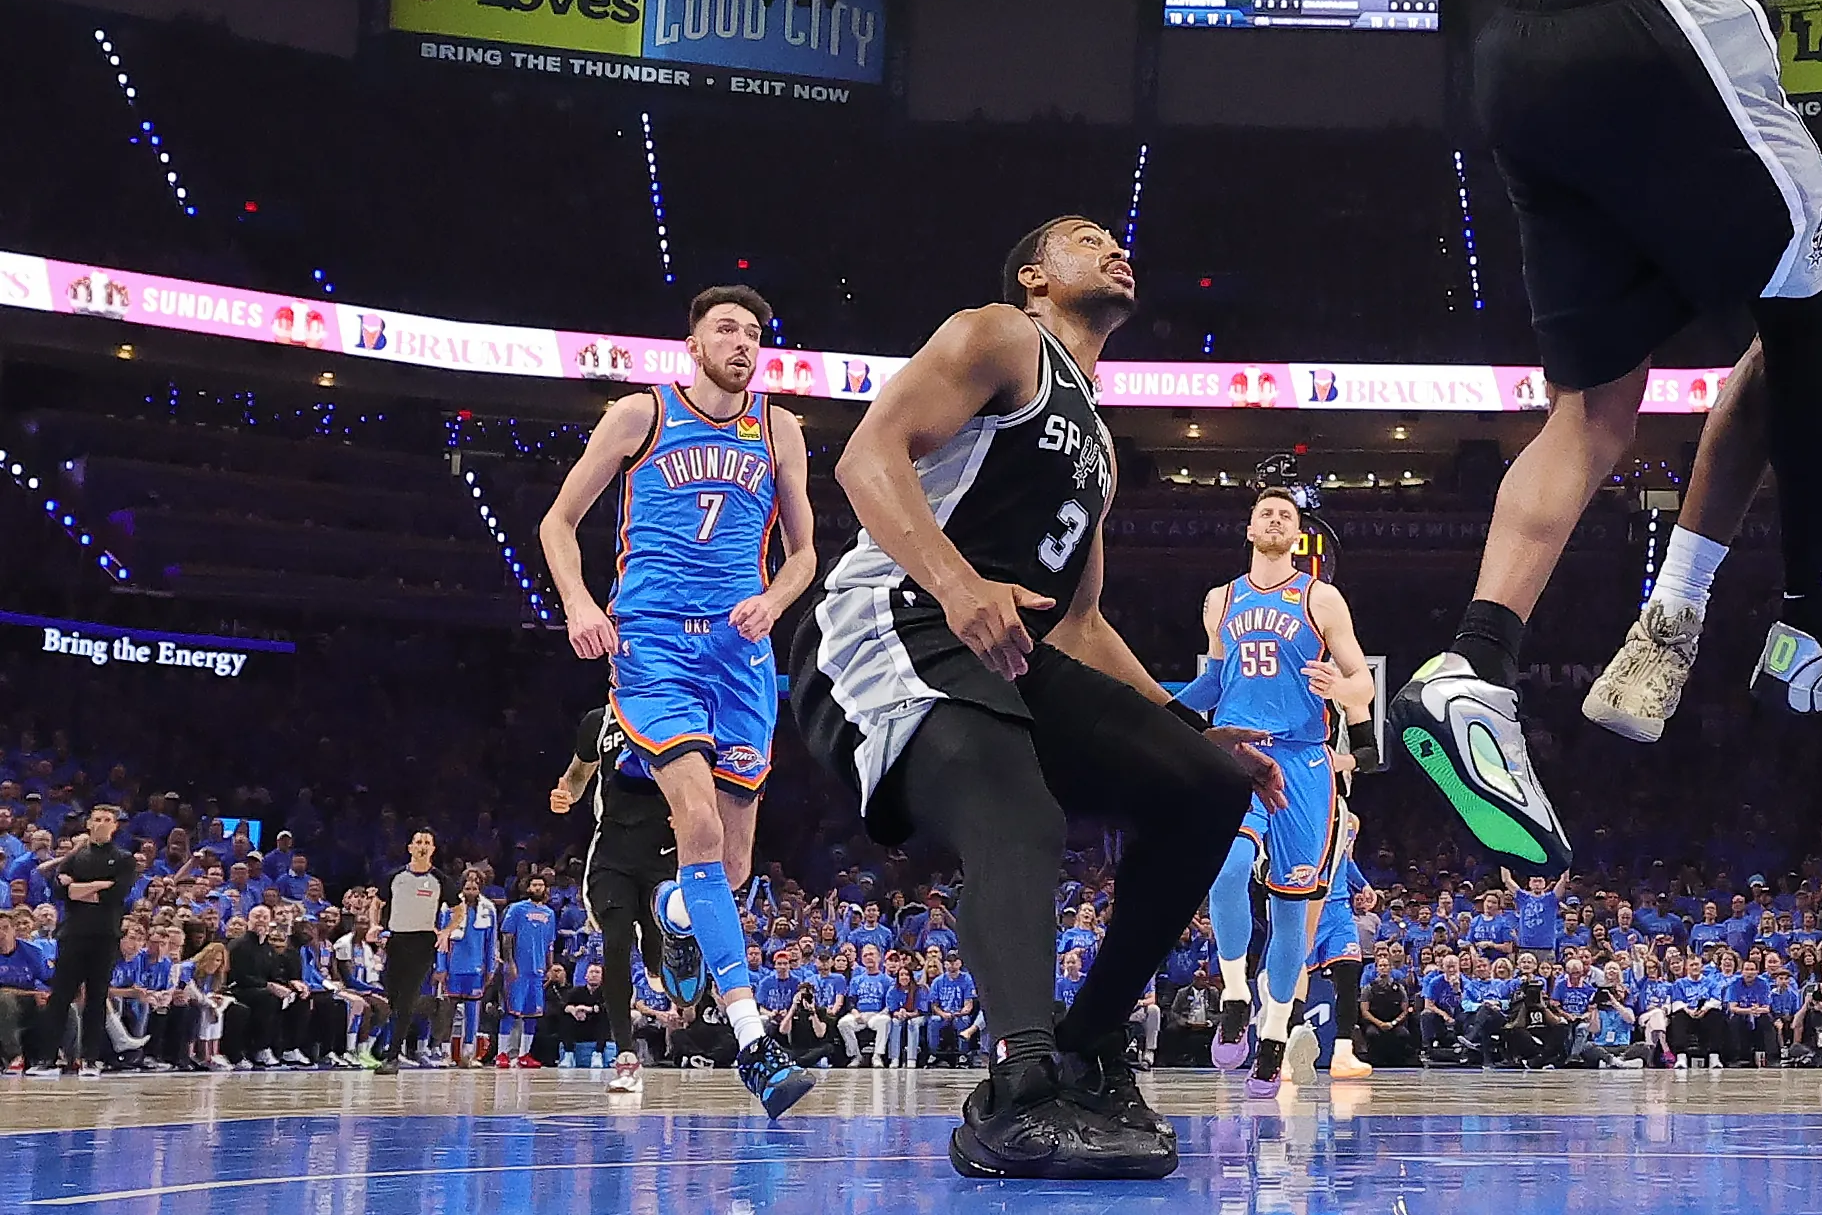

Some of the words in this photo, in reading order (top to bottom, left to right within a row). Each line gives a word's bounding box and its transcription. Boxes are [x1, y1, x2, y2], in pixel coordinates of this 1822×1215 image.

[1168, 12, 1183, 24] TO
[1186, 13, 1195, 25] 4
[1206, 13, 1219, 25] TF
[1388, 17, 1396, 28] 4
[1407, 17, 1419, 28] TF
[420, 42, 503, 67] BRING
[510, 49, 562, 74] THE
[568, 57, 691, 86] THUNDER
[730, 75, 786, 96] EXIT
[793, 83, 850, 104] NOW
[141, 287, 264, 329] SUNDAES
[394, 330, 544, 371] BRAUM'S
[1113, 372, 1220, 397] SUNDAES
[1345, 378, 1484, 404] BRAUM'S
[653, 445, 769, 494] THUNDER
[697, 491, 728, 543] 7
[1037, 499, 1089, 573] 3
[684, 618, 710, 634] OKC
[1226, 606, 1301, 641] THUNDER
[42, 627, 108, 665] Bring
[113, 637, 151, 663] the
[155, 641, 247, 676] Energy
[1239, 640, 1279, 678] 55
